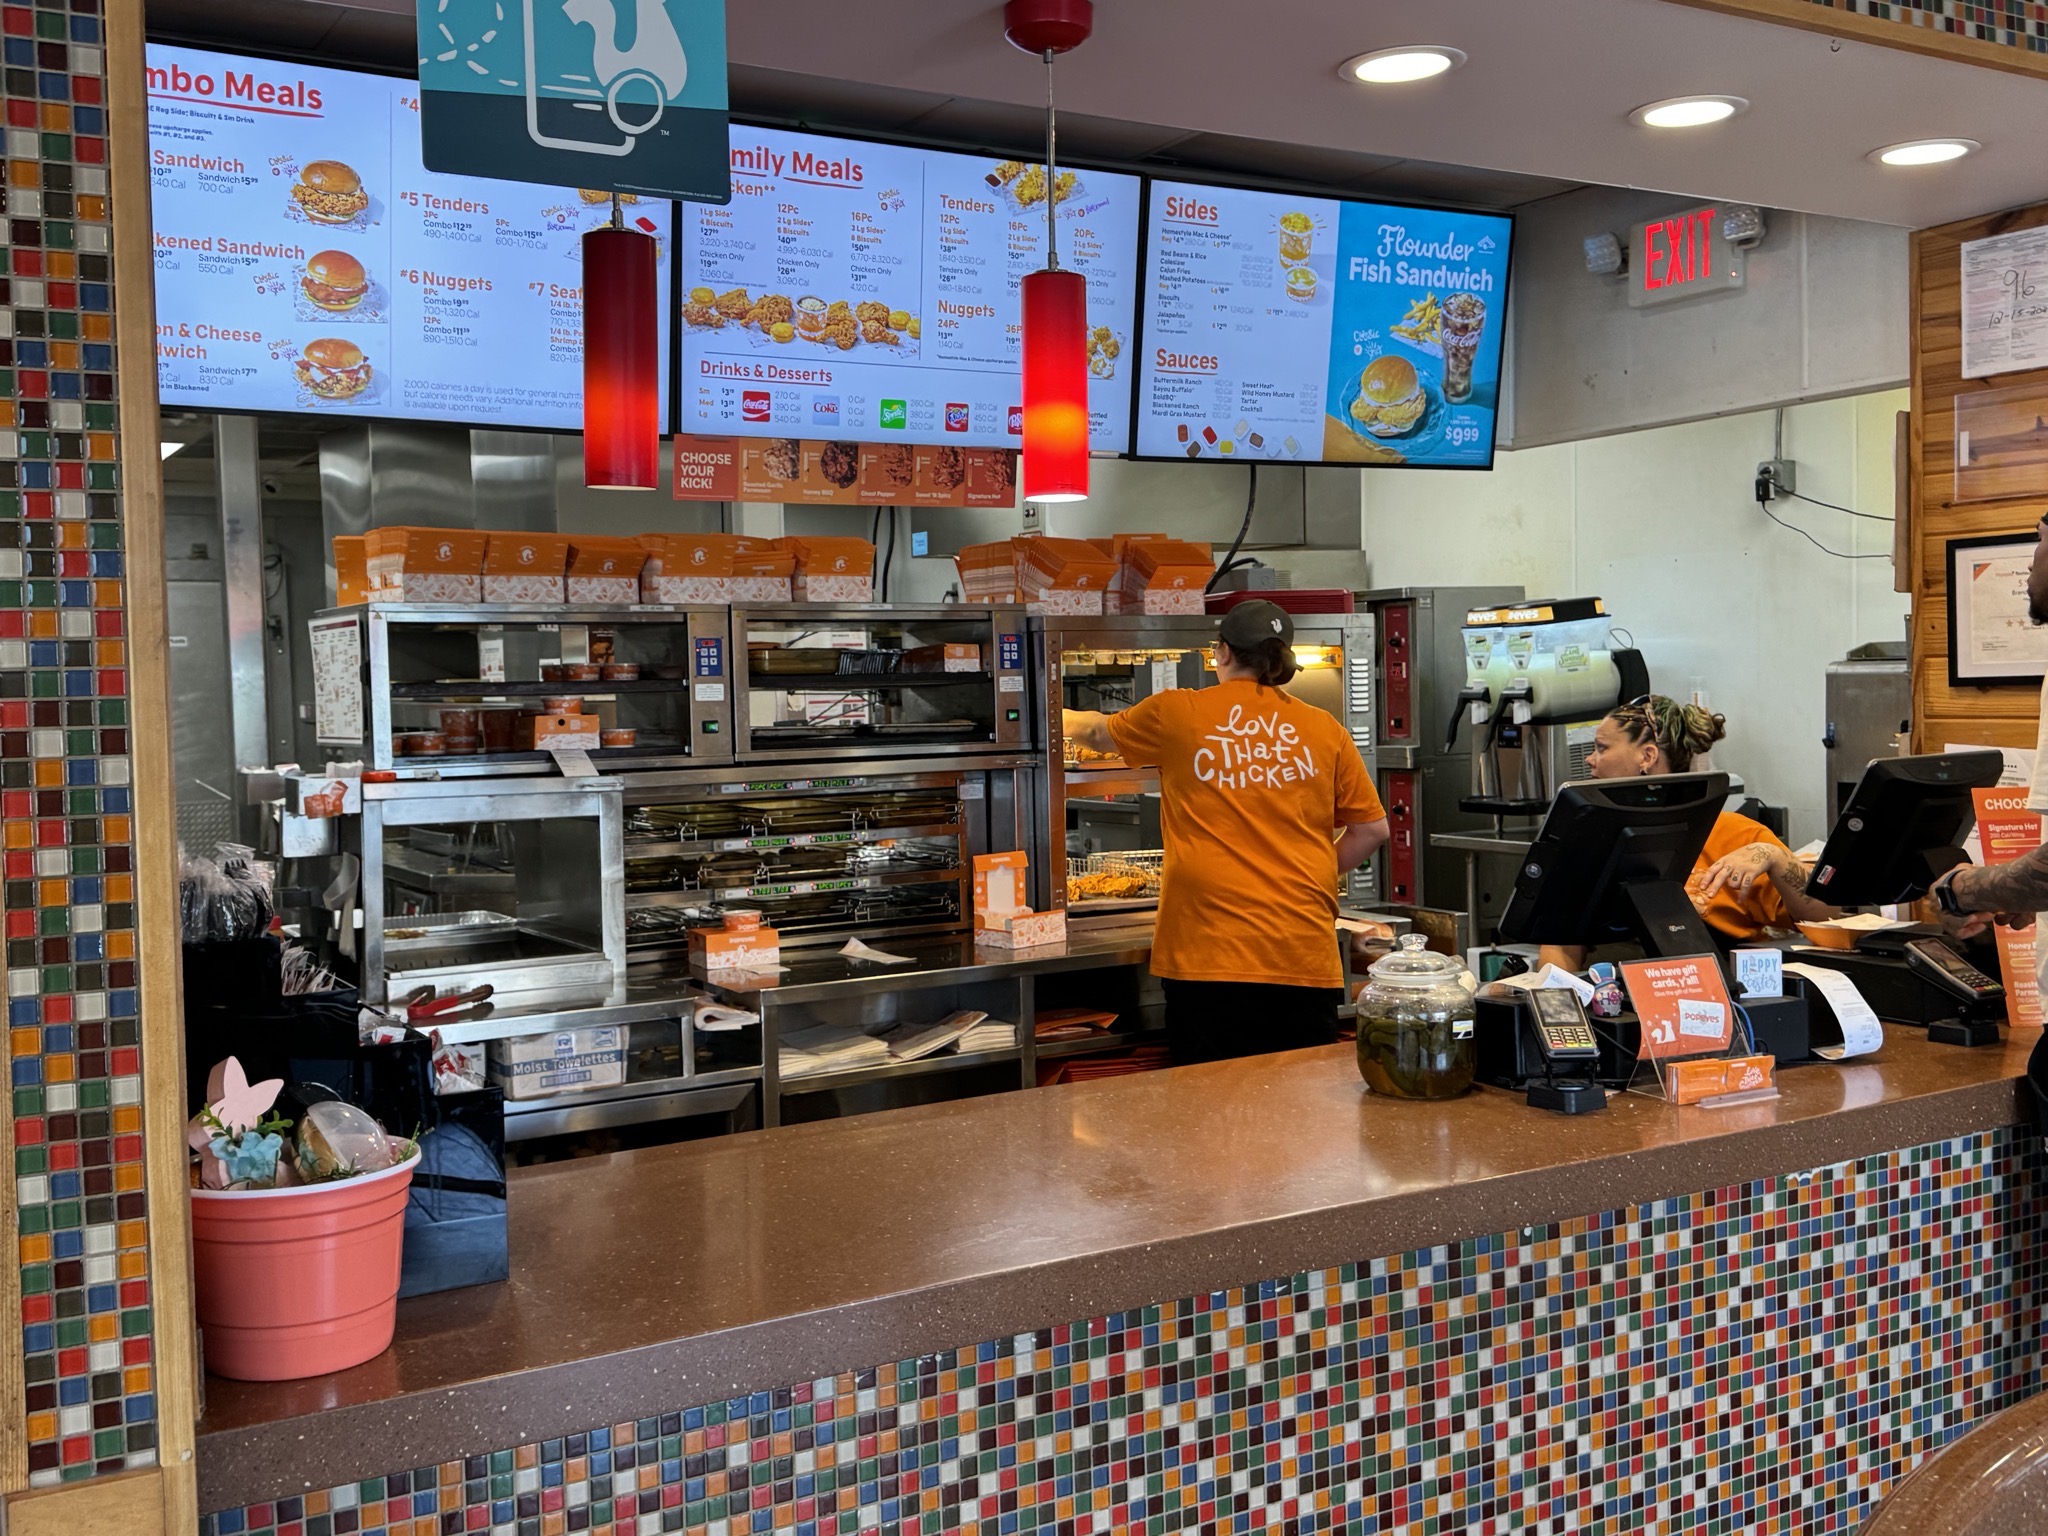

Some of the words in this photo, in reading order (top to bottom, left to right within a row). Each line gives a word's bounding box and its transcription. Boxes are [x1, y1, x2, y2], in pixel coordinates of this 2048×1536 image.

[225, 71, 323, 110] Meals
[400, 96, 419, 113] #4
[156, 106, 170, 116] Reg
[236, 115, 256, 124] Drink
[154, 148, 244, 175] Sandwich
[732, 146, 785, 178] mily
[792, 151, 864, 182] Meals
[198, 172, 240, 186] Sandwich
[197, 182, 218, 194] 700
[400, 191, 418, 207] #5
[422, 194, 490, 215] Tenders
[940, 194, 995, 214] Tenders
[1166, 196, 1219, 222] Sides
[424, 211, 438, 220] 3Pc
[777, 204, 800, 215] 12Pc
[496, 219, 510, 228] 5Pc
[706, 219, 734, 229] Biscuits
[851, 212, 874, 224] 16Pc
[940, 214, 960, 225] 12Pc
[424, 220, 452, 231] Combo
[1008, 221, 1028, 232] 16Pc
[496, 228, 524, 239] Combo
[783, 228, 810, 237] Biscuits
[1074, 228, 1096, 239] 20Pc
[1162, 228, 1192, 238] Homestyle
[1192, 230, 1204, 238] Mac
[217, 238, 306, 261] Sandwich
[1377, 224, 1474, 263] Flounder
[1645, 208, 1716, 290] EXIT
[198, 254, 241, 268] Sandwich
[700, 250, 728, 260] Chicken
[730, 254, 745, 263] Only
[1195, 253, 1207, 261] Rice
[777, 258, 804, 268] Chicken
[805, 260, 820, 270] Only
[1160, 259, 1186, 267] Coleslaw
[198, 264, 218, 275] 550
[850, 265, 876, 276] Chicken
[877, 267, 892, 277] Only
[939, 265, 965, 276] Tenders
[966, 268, 978, 278] Only
[1160, 268, 1176, 276] Cajun
[1176, 268, 1190, 276] Fries
[1349, 256, 1391, 284] Fish
[1395, 261, 1494, 292] Sandwich
[400, 269, 418, 285] #6
[422, 271, 492, 292] Nuggets
[1181, 277, 1206, 285] Potatoes
[2003, 269, 2036, 300] 96
[424, 288, 438, 297] 8Pc
[528, 281, 545, 297] #7
[424, 296, 452, 308] Combo
[550, 308, 578, 319] Combo
[938, 299, 996, 318] Nuggets
[424, 316, 441, 326] 12Pc
[937, 319, 960, 330] 24Pc
[178, 323, 191, 338] &
[195, 324, 262, 343] Cheese
[424, 325, 452, 336] Combo
[550, 336, 577, 347] Shrimp
[550, 345, 578, 355] Combo
[1156, 348, 1218, 371] Sauces
[199, 366, 242, 378] Sandwich
[701, 360, 750, 378] Drinks
[754, 364, 764, 378] &
[768, 364, 832, 384] Desserts
[199, 375, 218, 386] 830
[1154, 376, 1184, 385] Buttermilk
[1184, 379, 1202, 387] Ranch
[1242, 382, 1259, 390] Sweet
[174, 384, 210, 394] Blackened
[430, 382, 462, 393] calories
[468, 384, 484, 396] day
[494, 386, 514, 395] used
[515, 388, 527, 396] for
[528, 389, 558, 400] general
[698, 387, 711, 396] Sm
[1153, 386, 1171, 394] Bayou
[404, 390, 416, 399] but
[418, 391, 448, 401] calorie
[449, 393, 473, 402] needs
[494, 394, 534, 405] Additional
[775, 392, 788, 401] 270
[1242, 390, 1254, 398] Wild
[1255, 391, 1272, 400] Honey
[1272, 392, 1295, 401] Mustard
[412, 401, 446, 411] available
[448, 404, 470, 413] upon
[698, 398, 714, 408] Med
[814, 402, 840, 415] Coke
[1152, 402, 1181, 411] Blackened
[1182, 403, 1200, 412] Ranch
[1241, 398, 1258, 407] Tartar
[698, 410, 708, 420] Lg
[1152, 410, 1168, 419] Mardi
[1169, 411, 1182, 419] Gras
[1183, 412, 1206, 421] Mustard
[1240, 406, 1263, 415] Cocktail
[680, 452, 732, 466] CHOOSE
[680, 464, 714, 478] YOUR
[680, 478, 713, 490] KICK!
[1988, 824, 2024, 833] Signature
[2024, 823, 2038, 832] Hot
[1644, 968, 1661, 980] We
[1661, 966, 1682, 978] have
[1682, 964, 1698, 978] gift
[1652, 977, 1680, 990] cards,
[514, 1062, 548, 1076] Moist
[553, 1053, 616, 1071] Towelettes
